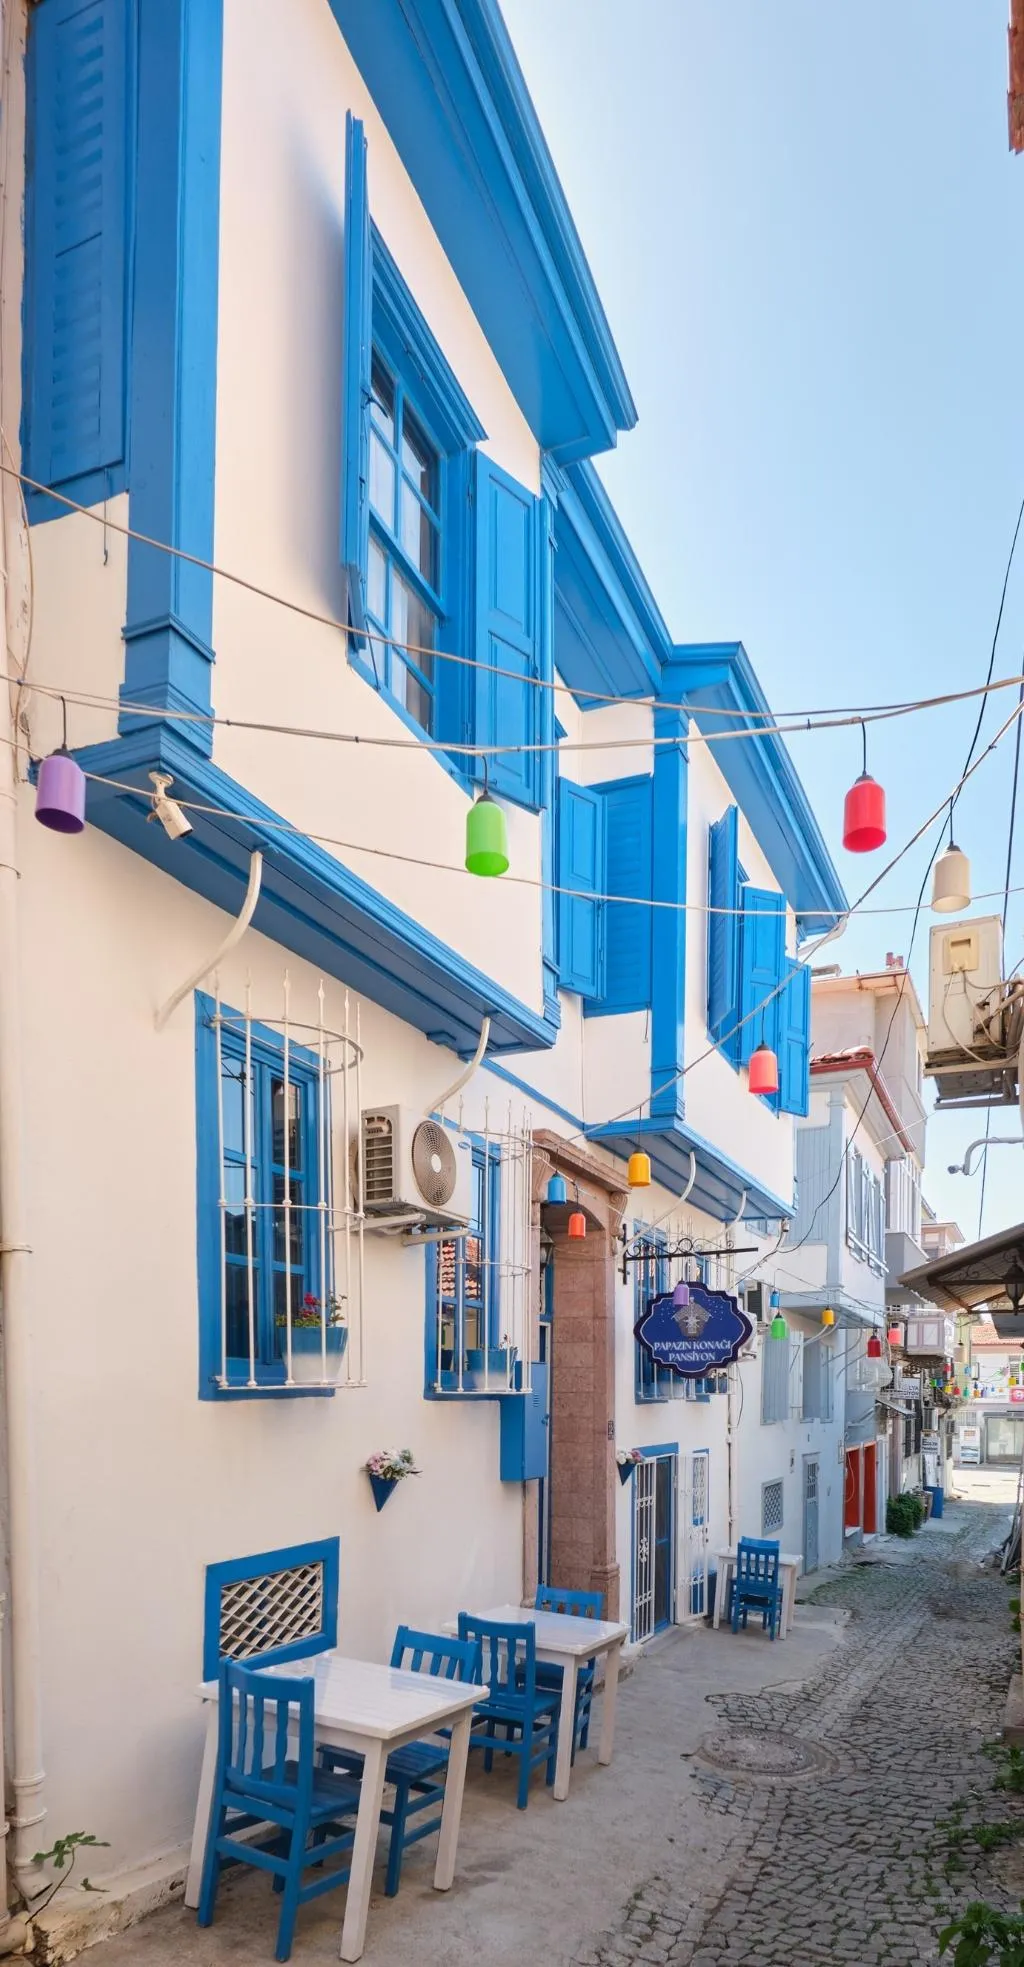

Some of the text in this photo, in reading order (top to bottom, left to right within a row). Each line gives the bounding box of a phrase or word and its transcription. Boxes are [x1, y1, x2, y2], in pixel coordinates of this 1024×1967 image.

[654, 1340, 731, 1351] PAPAZIN KONAĞI
[669, 1351, 716, 1361] PANSİYON
